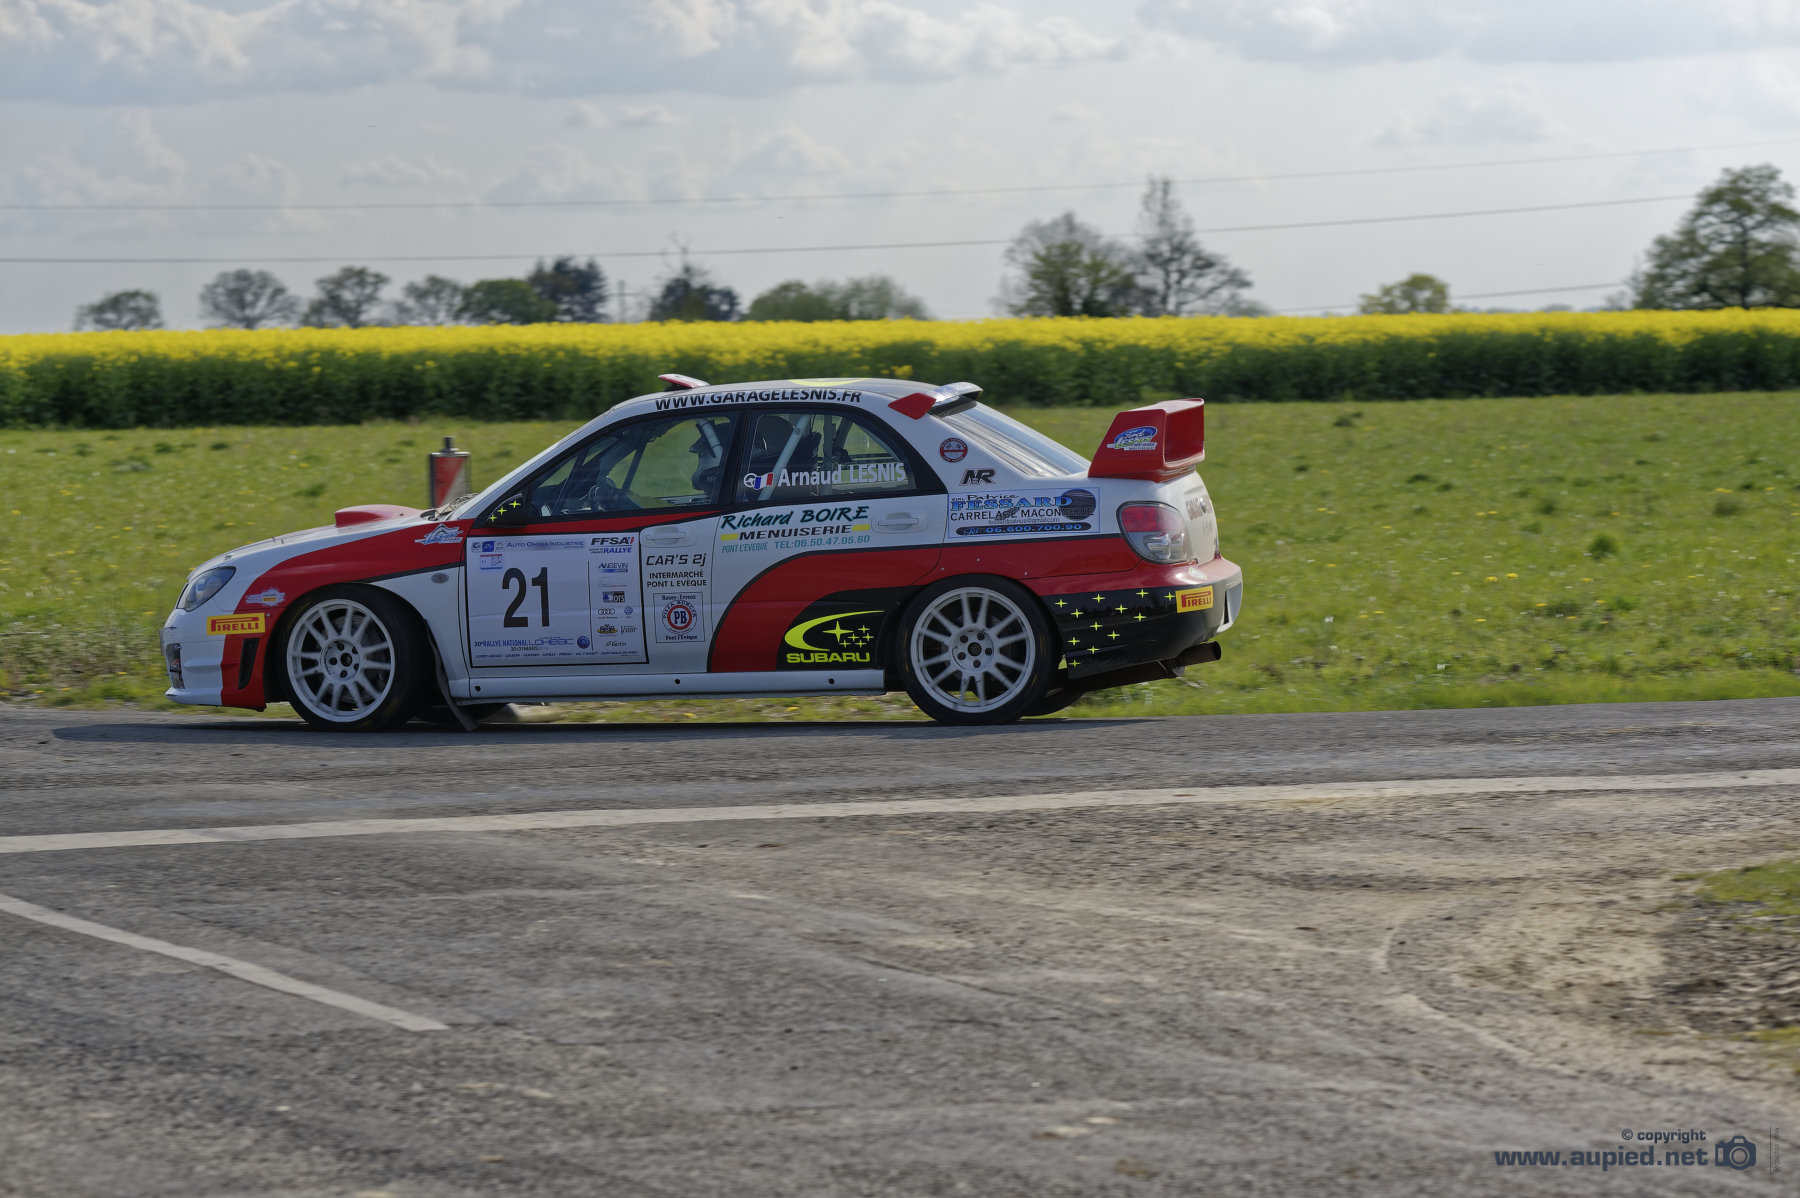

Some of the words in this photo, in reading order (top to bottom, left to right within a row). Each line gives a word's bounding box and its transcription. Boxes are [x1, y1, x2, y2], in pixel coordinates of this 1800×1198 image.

[655, 389, 862, 411] WWW.GARAGELESNIS.FR
[777, 466, 842, 488] Arnaud
[849, 462, 906, 483] LESNIS
[720, 510, 794, 530] Richard
[800, 505, 869, 523] BOIRE
[738, 524, 854, 541] MENUISERIE
[591, 537, 630, 546] FFSA
[646, 554, 689, 566] CAR'S
[649, 571, 705, 579] INTERMARCHE
[647, 580, 667, 588] PONT
[676, 579, 708, 587] EVEQUE
[501, 567, 550, 628] 21
[1181, 591, 1212, 609] PIRELLI
[210, 616, 261, 632] PIRELLI
[673, 610, 688, 625] PB
[786, 652, 871, 663] SUBARU
